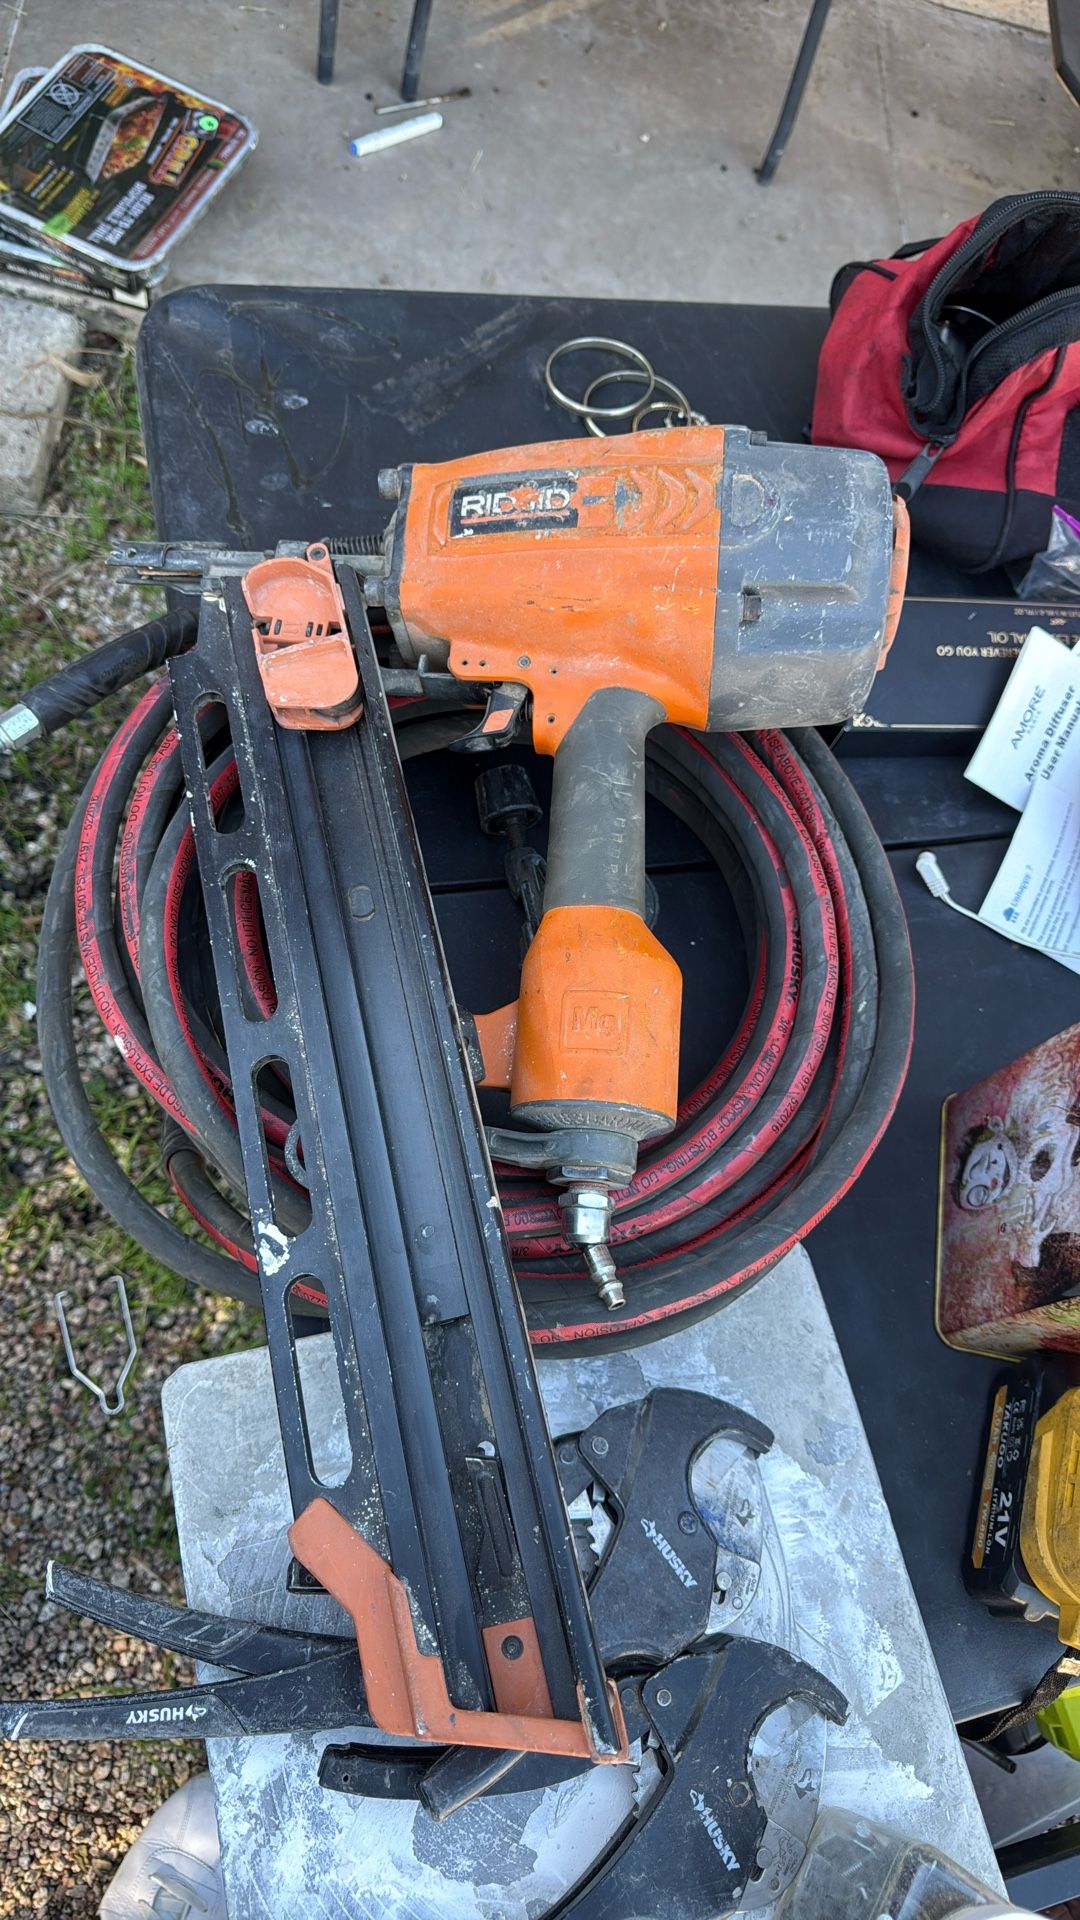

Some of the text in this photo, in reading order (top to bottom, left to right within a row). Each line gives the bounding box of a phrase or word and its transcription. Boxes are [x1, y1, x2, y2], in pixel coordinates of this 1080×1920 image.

[461, 487, 570, 517] RIDID
[986, 630, 1009, 644] OIL
[936, 644, 954, 657] GO
[955, 644, 979, 657] YOU
[1010, 685, 1046, 750] AMORE
[1024, 739, 1050, 782] Aroma
[1044, 684, 1075, 738] Diffuser
[774, 752, 802, 787] ABOVE
[1040, 749, 1062, 780] User
[127, 804, 140, 823] DO
[134, 777, 151, 802] NOT
[144, 754, 163, 778] USE
[78, 839, 90, 862] 2197
[76, 872, 85, 891] PSI
[170, 880, 183, 904] USE
[76, 894, 86, 912] 300
[822, 896, 833, 914] NO
[77, 914, 88, 929] DE
[169, 905, 178, 929] NOT
[240, 895, 256, 937] UTILICE
[245, 938, 259, 956] NO
[824, 916, 837, 961] UTILICE
[86, 959, 105, 999] UTILICE
[785, 940, 802, 1002] HUSKY
[97, 999, 115, 1019] NO
[823, 990, 836, 1009] DE
[818, 1009, 833, 1033] 300
[812, 1032, 827, 1054] PSI
[746, 1042, 782, 1090] CAUTION
[796, 1061, 817, 1091] 2197
[151, 1078, 170, 1097] DE
[699, 1082, 718, 1102] DO
[712, 1112, 733, 1134] OF
[769, 1095, 800, 1134] 522016
[662, 1126, 719, 1176] BURSTING
[639, 1170, 661, 1189] DO
[613, 1182, 641, 1202] NOT
[992, 1491, 1013, 1547] 21V
[653, 1532, 698, 1589] HUSKY
[126, 1706, 185, 1724] HUSKY
[699, 1807, 741, 1872] HUSKY
